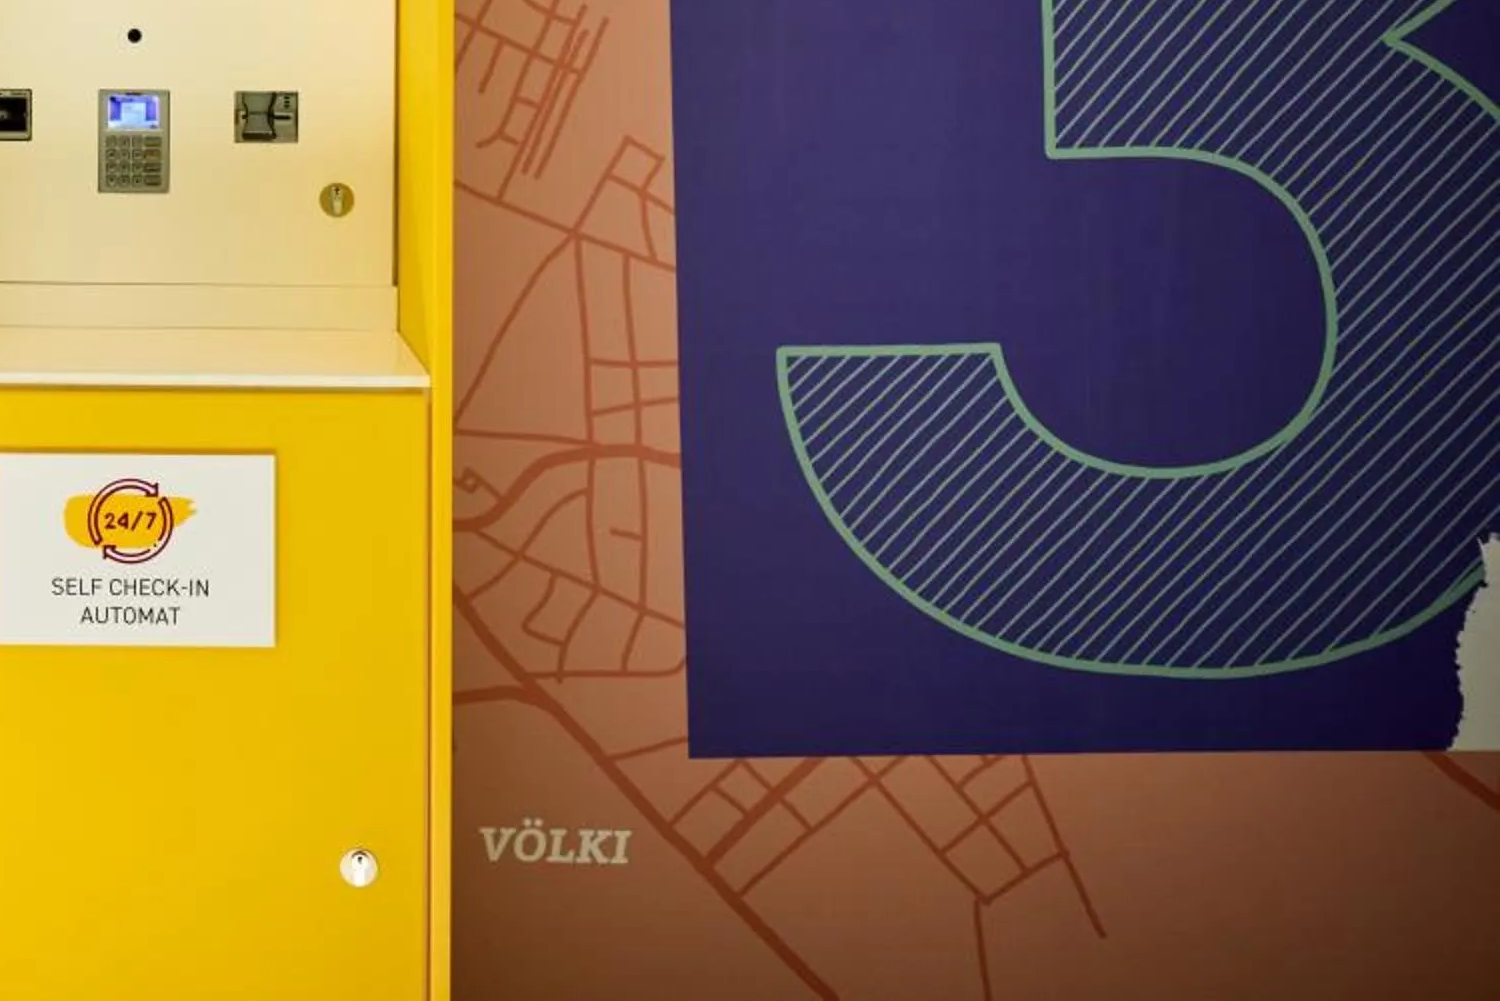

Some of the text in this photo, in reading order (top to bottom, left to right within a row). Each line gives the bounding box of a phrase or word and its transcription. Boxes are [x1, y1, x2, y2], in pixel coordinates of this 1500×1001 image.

[103, 510, 157, 531] 24/7
[51, 578, 210, 597] SELF CHECK-IN
[79, 606, 181, 625] AUTOMAT
[478, 818, 633, 864] VÖLKI
